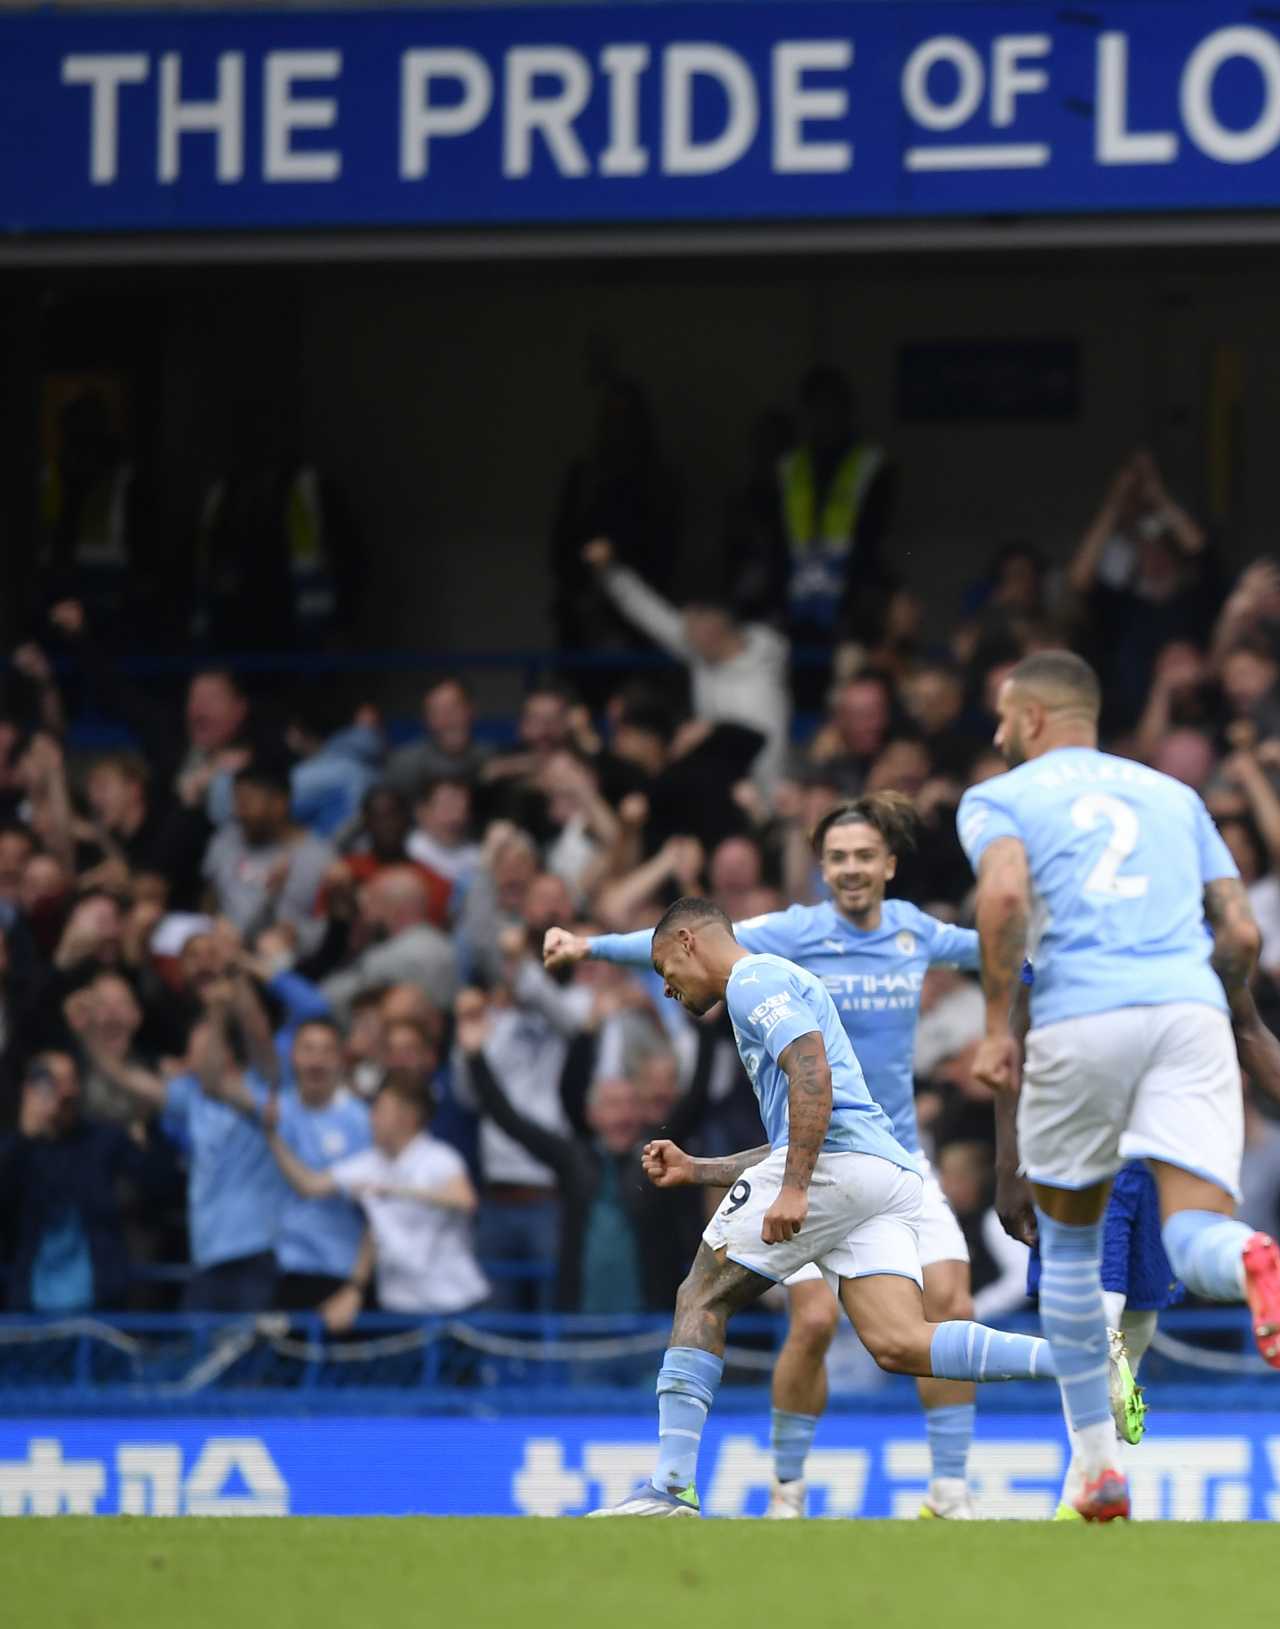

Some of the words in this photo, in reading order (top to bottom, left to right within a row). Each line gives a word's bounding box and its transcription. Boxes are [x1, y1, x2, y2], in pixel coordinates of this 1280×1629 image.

[61, 50, 343, 186] THE
[400, 41, 855, 180] PRIDE
[900, 34, 1052, 132] OF
[1071, 793, 1150, 898] 2
[747, 991, 792, 1026] NEXEN
[760, 1005, 793, 1029] TIRE
[721, 1179, 752, 1216] 9
